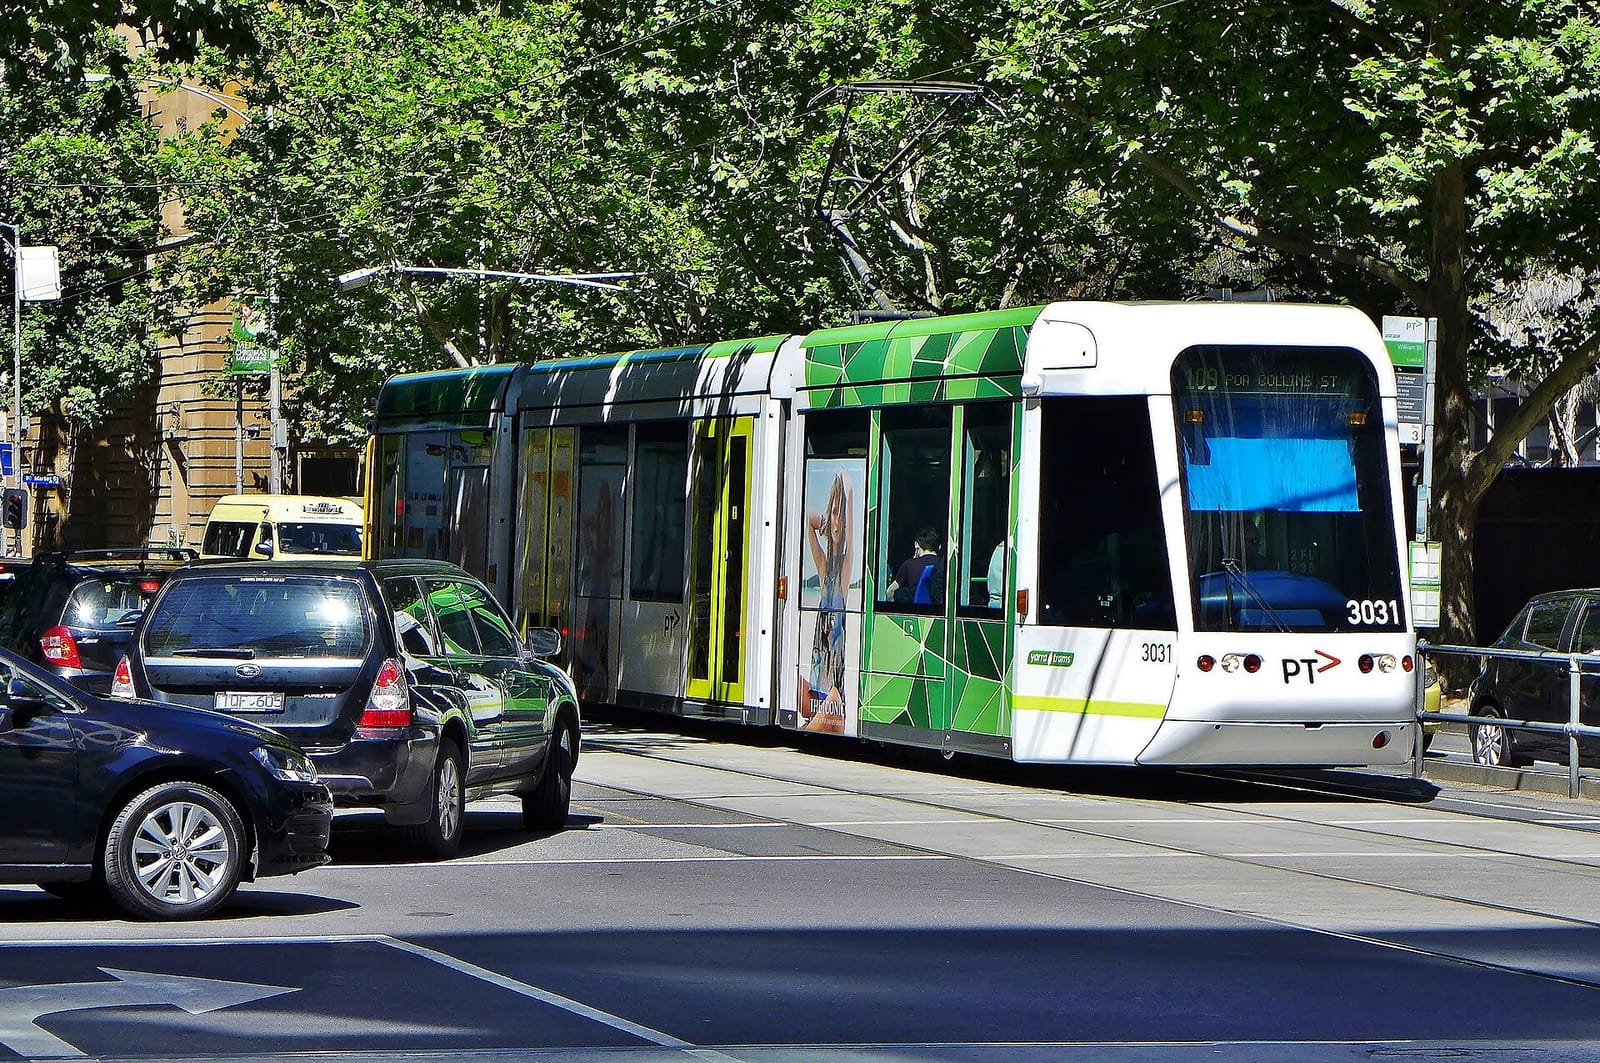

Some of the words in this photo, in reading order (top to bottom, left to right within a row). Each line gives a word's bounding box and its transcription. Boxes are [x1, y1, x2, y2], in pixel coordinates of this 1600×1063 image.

[1185, 368, 1218, 390] 109
[1258, 374, 1313, 388] COLLINS
[1320, 375, 1338, 388] ST
[1411, 430, 1419, 441] 3
[1346, 599, 1399, 626] 3031
[1030, 652, 1048, 663] yarra
[1052, 652, 1072, 664] trams
[1141, 642, 1172, 664] 3031
